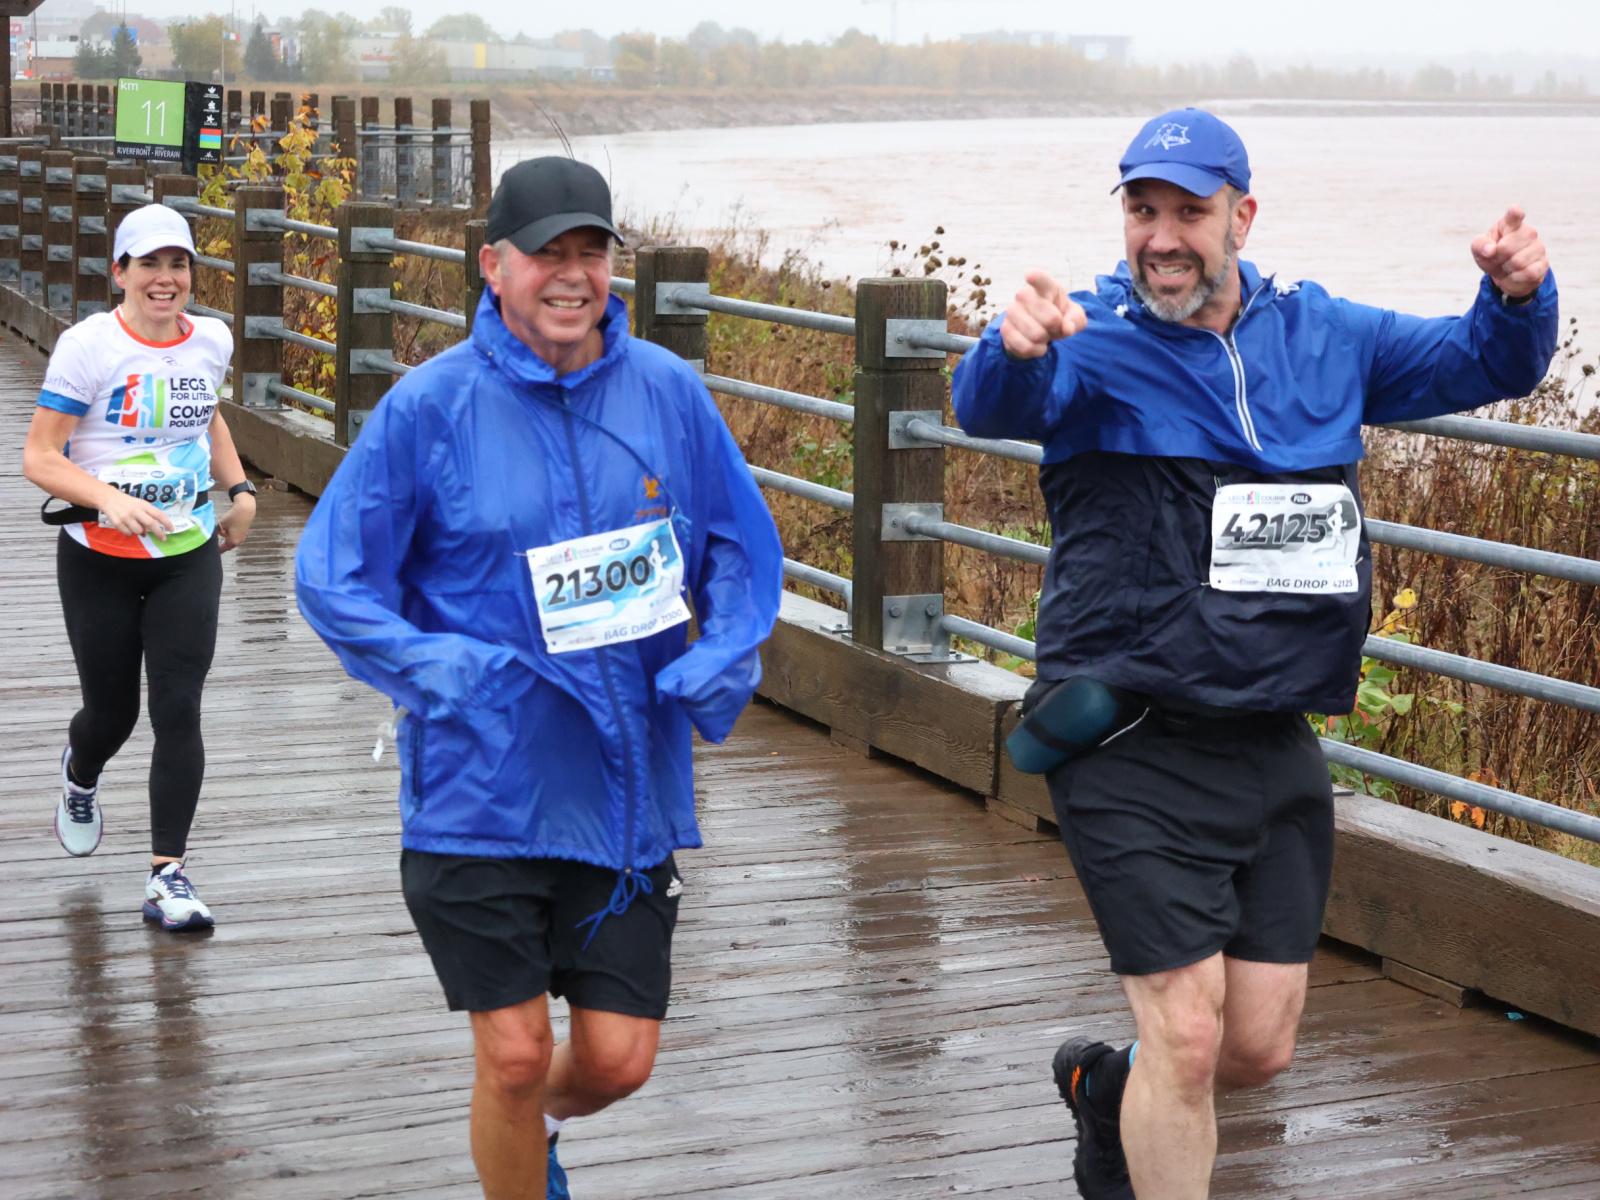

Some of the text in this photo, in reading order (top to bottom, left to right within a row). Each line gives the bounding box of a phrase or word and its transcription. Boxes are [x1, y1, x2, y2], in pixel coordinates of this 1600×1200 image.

[120, 81, 139, 91] km
[141, 99, 166, 137] 11
[170, 377, 207, 391] LEGS
[170, 392, 190, 401] FOR
[169, 420, 195, 428] POUR
[1221, 512, 1329, 544] 42125
[545, 555, 651, 607] 21300
[1266, 578, 1291, 588] BAG
[1293, 579, 1329, 589] DROP
[1332, 579, 1353, 588] 42125
[604, 627, 628, 640] BAG
[631, 618, 658, 635] DROP
